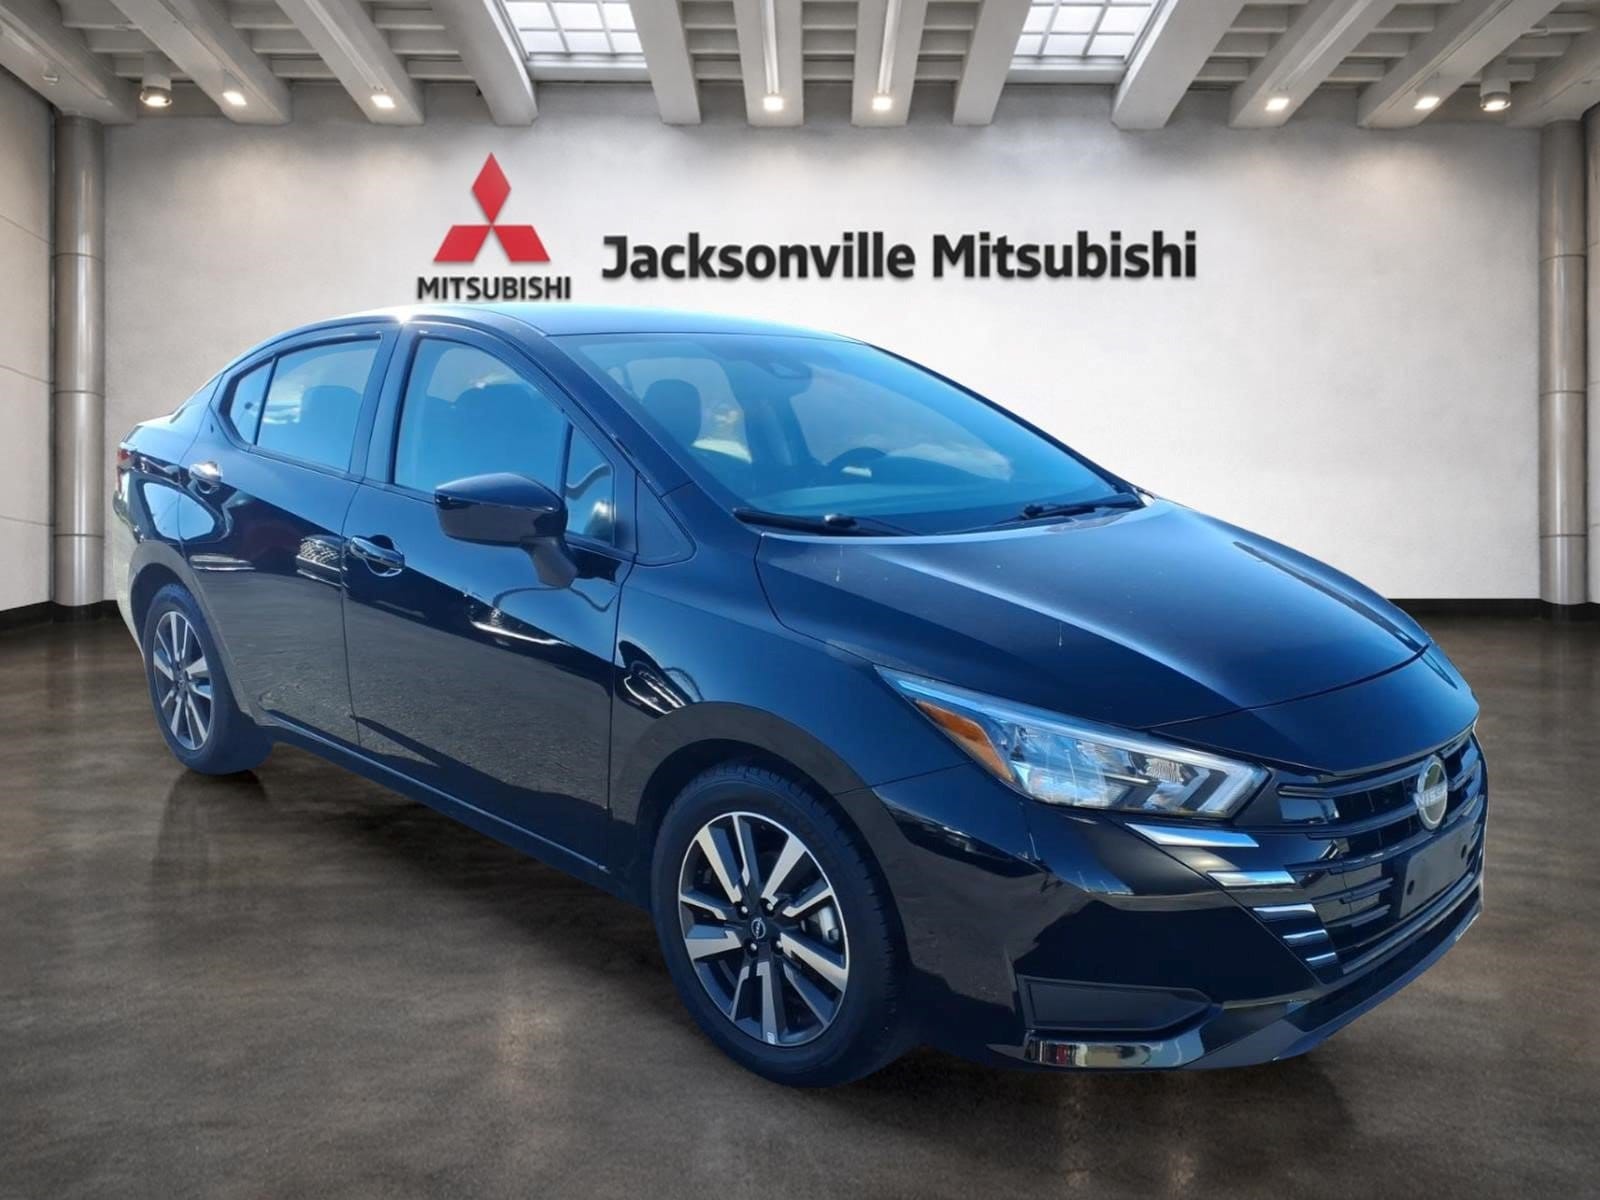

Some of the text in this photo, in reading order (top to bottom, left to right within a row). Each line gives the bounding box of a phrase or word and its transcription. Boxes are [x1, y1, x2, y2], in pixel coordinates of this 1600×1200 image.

[602, 230, 1196, 280] Jacksonville Mitsubishi
[417, 277, 572, 300] MITSUBISHI
